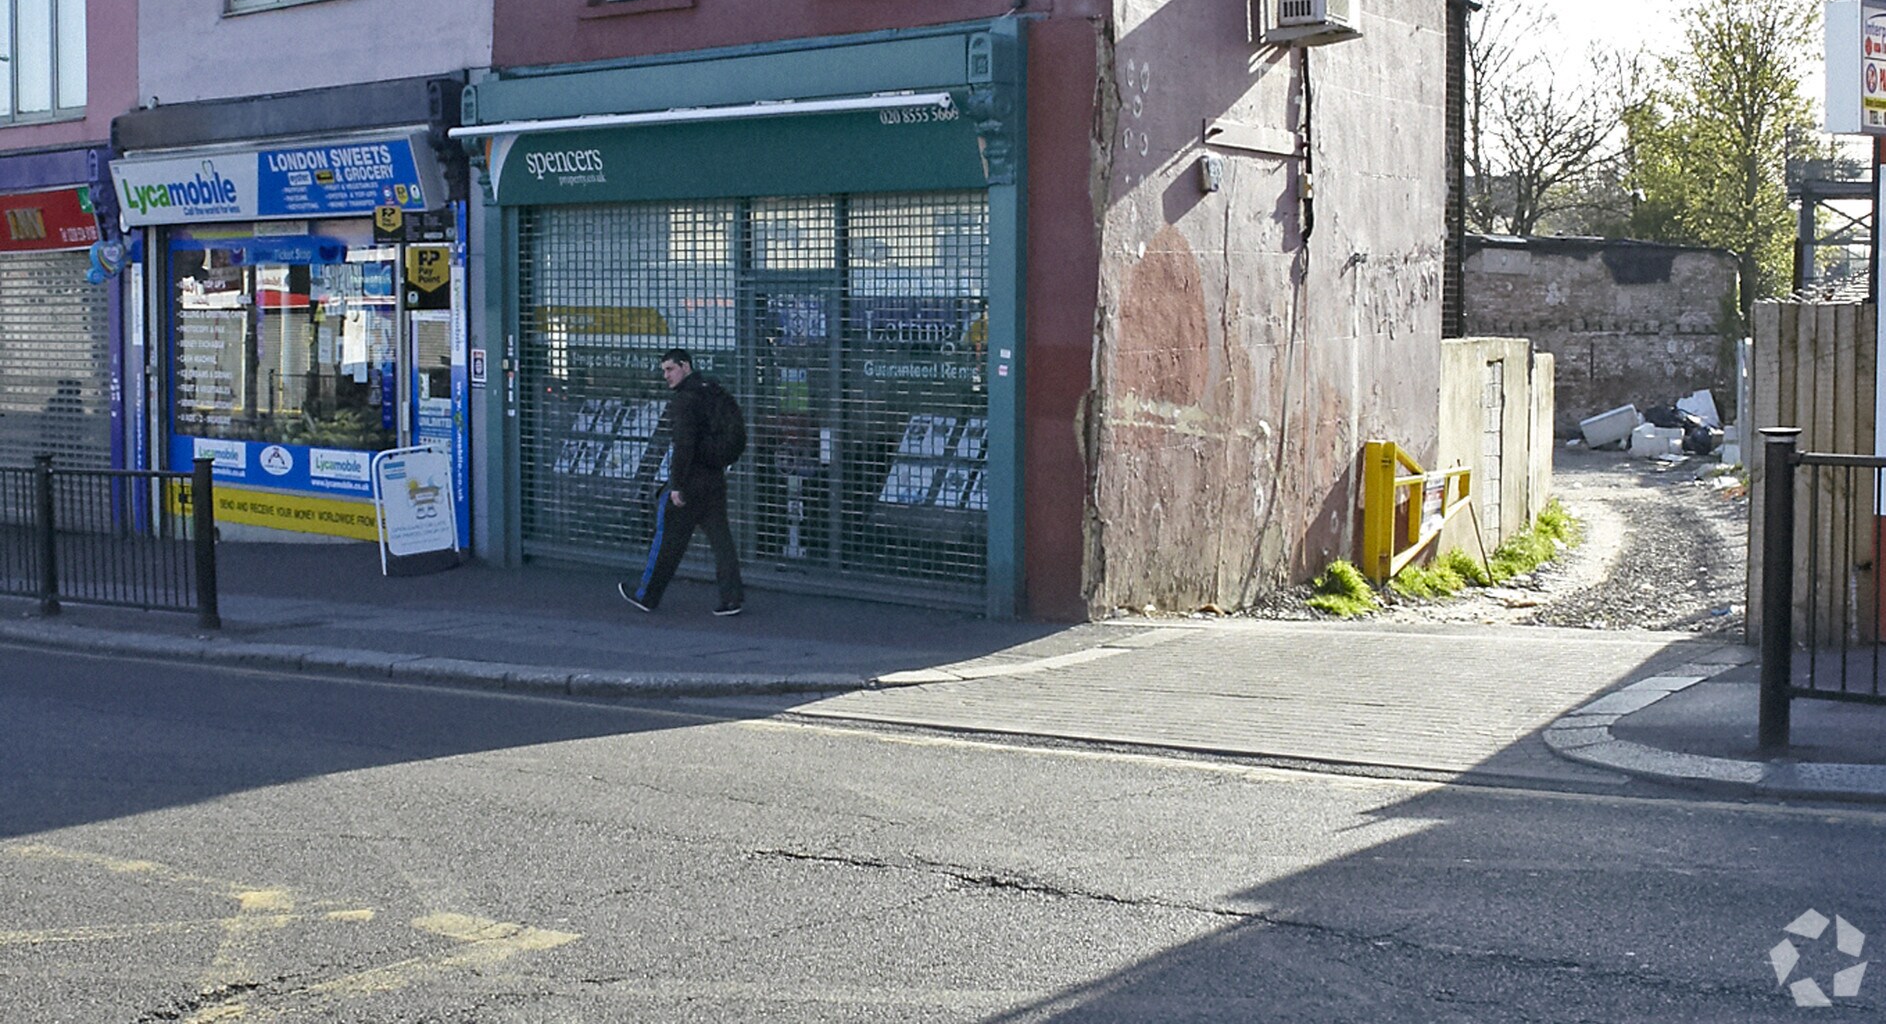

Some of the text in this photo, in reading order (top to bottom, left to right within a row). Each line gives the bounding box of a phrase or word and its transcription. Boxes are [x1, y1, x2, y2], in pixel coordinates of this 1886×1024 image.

[880, 105, 959, 125] 020 8555 5666
[268, 144, 392, 172] LONDON SWEETS
[525, 149, 604, 180] spencers
[335, 169, 344, 183] &
[344, 164, 394, 182] GROCERY
[122, 171, 237, 216] Lycamobile
[419, 267, 434, 277] Pay
[419, 275, 441, 283] Point
[864, 360, 938, 378] Guaranteed
[315, 455, 362, 474] Lycamobile
[311, 478, 369, 492] www.lycamobile.co.uk
[219, 498, 235, 510] SEND
[236, 501, 249, 512] AND
[249, 503, 275, 516] RECEIVE
[276, 507, 292, 518] YOUR
[293, 508, 315, 520] MONEY
[317, 511, 356, 526] WORLDWIDE
[356, 515, 375, 527] FROM
